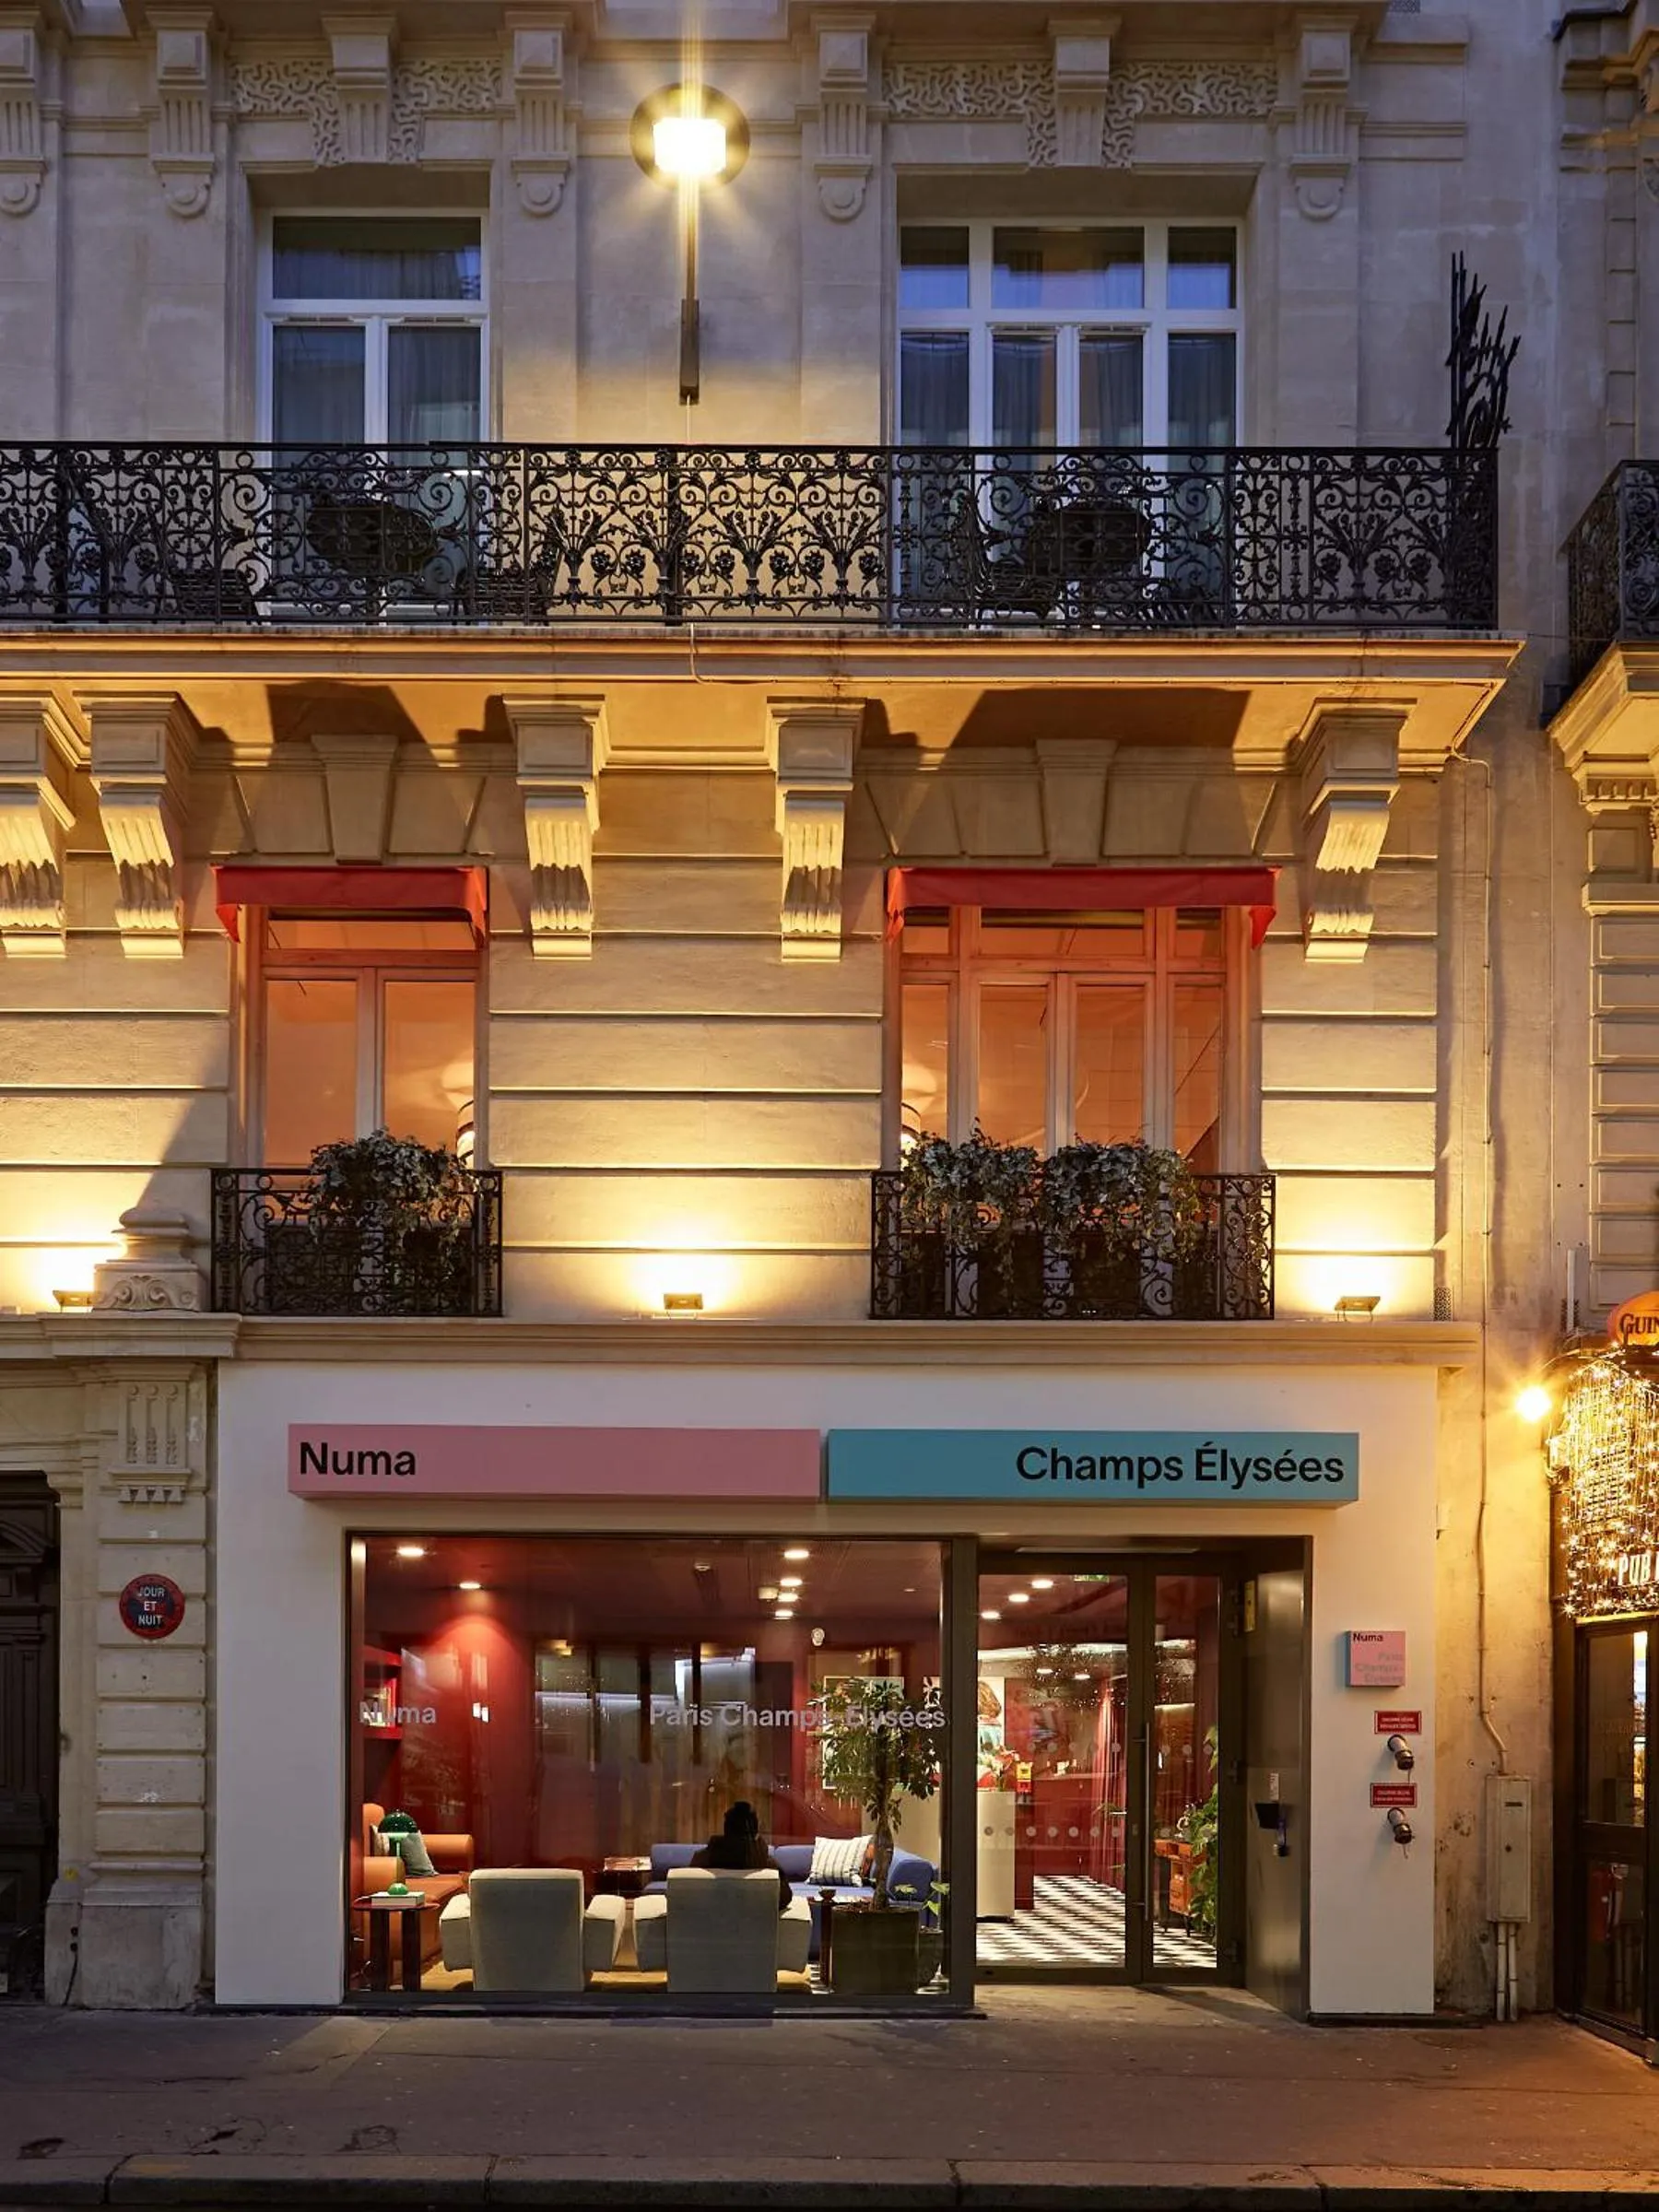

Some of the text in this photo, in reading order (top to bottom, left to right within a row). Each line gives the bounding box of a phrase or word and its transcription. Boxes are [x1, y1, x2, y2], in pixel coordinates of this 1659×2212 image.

[300, 1442, 416, 1476] Numa
[1017, 1441, 1345, 1490] Champs Élysées
[1618, 1552, 1652, 1586] PUB
[137, 1586, 165, 1597] JOUR
[144, 1601, 157, 1611] ET
[137, 1615, 162, 1626] NUIT
[1353, 1632, 1383, 1642] Numa
[359, 1700, 436, 1724] Numa
[650, 1704, 713, 1727] Paris
